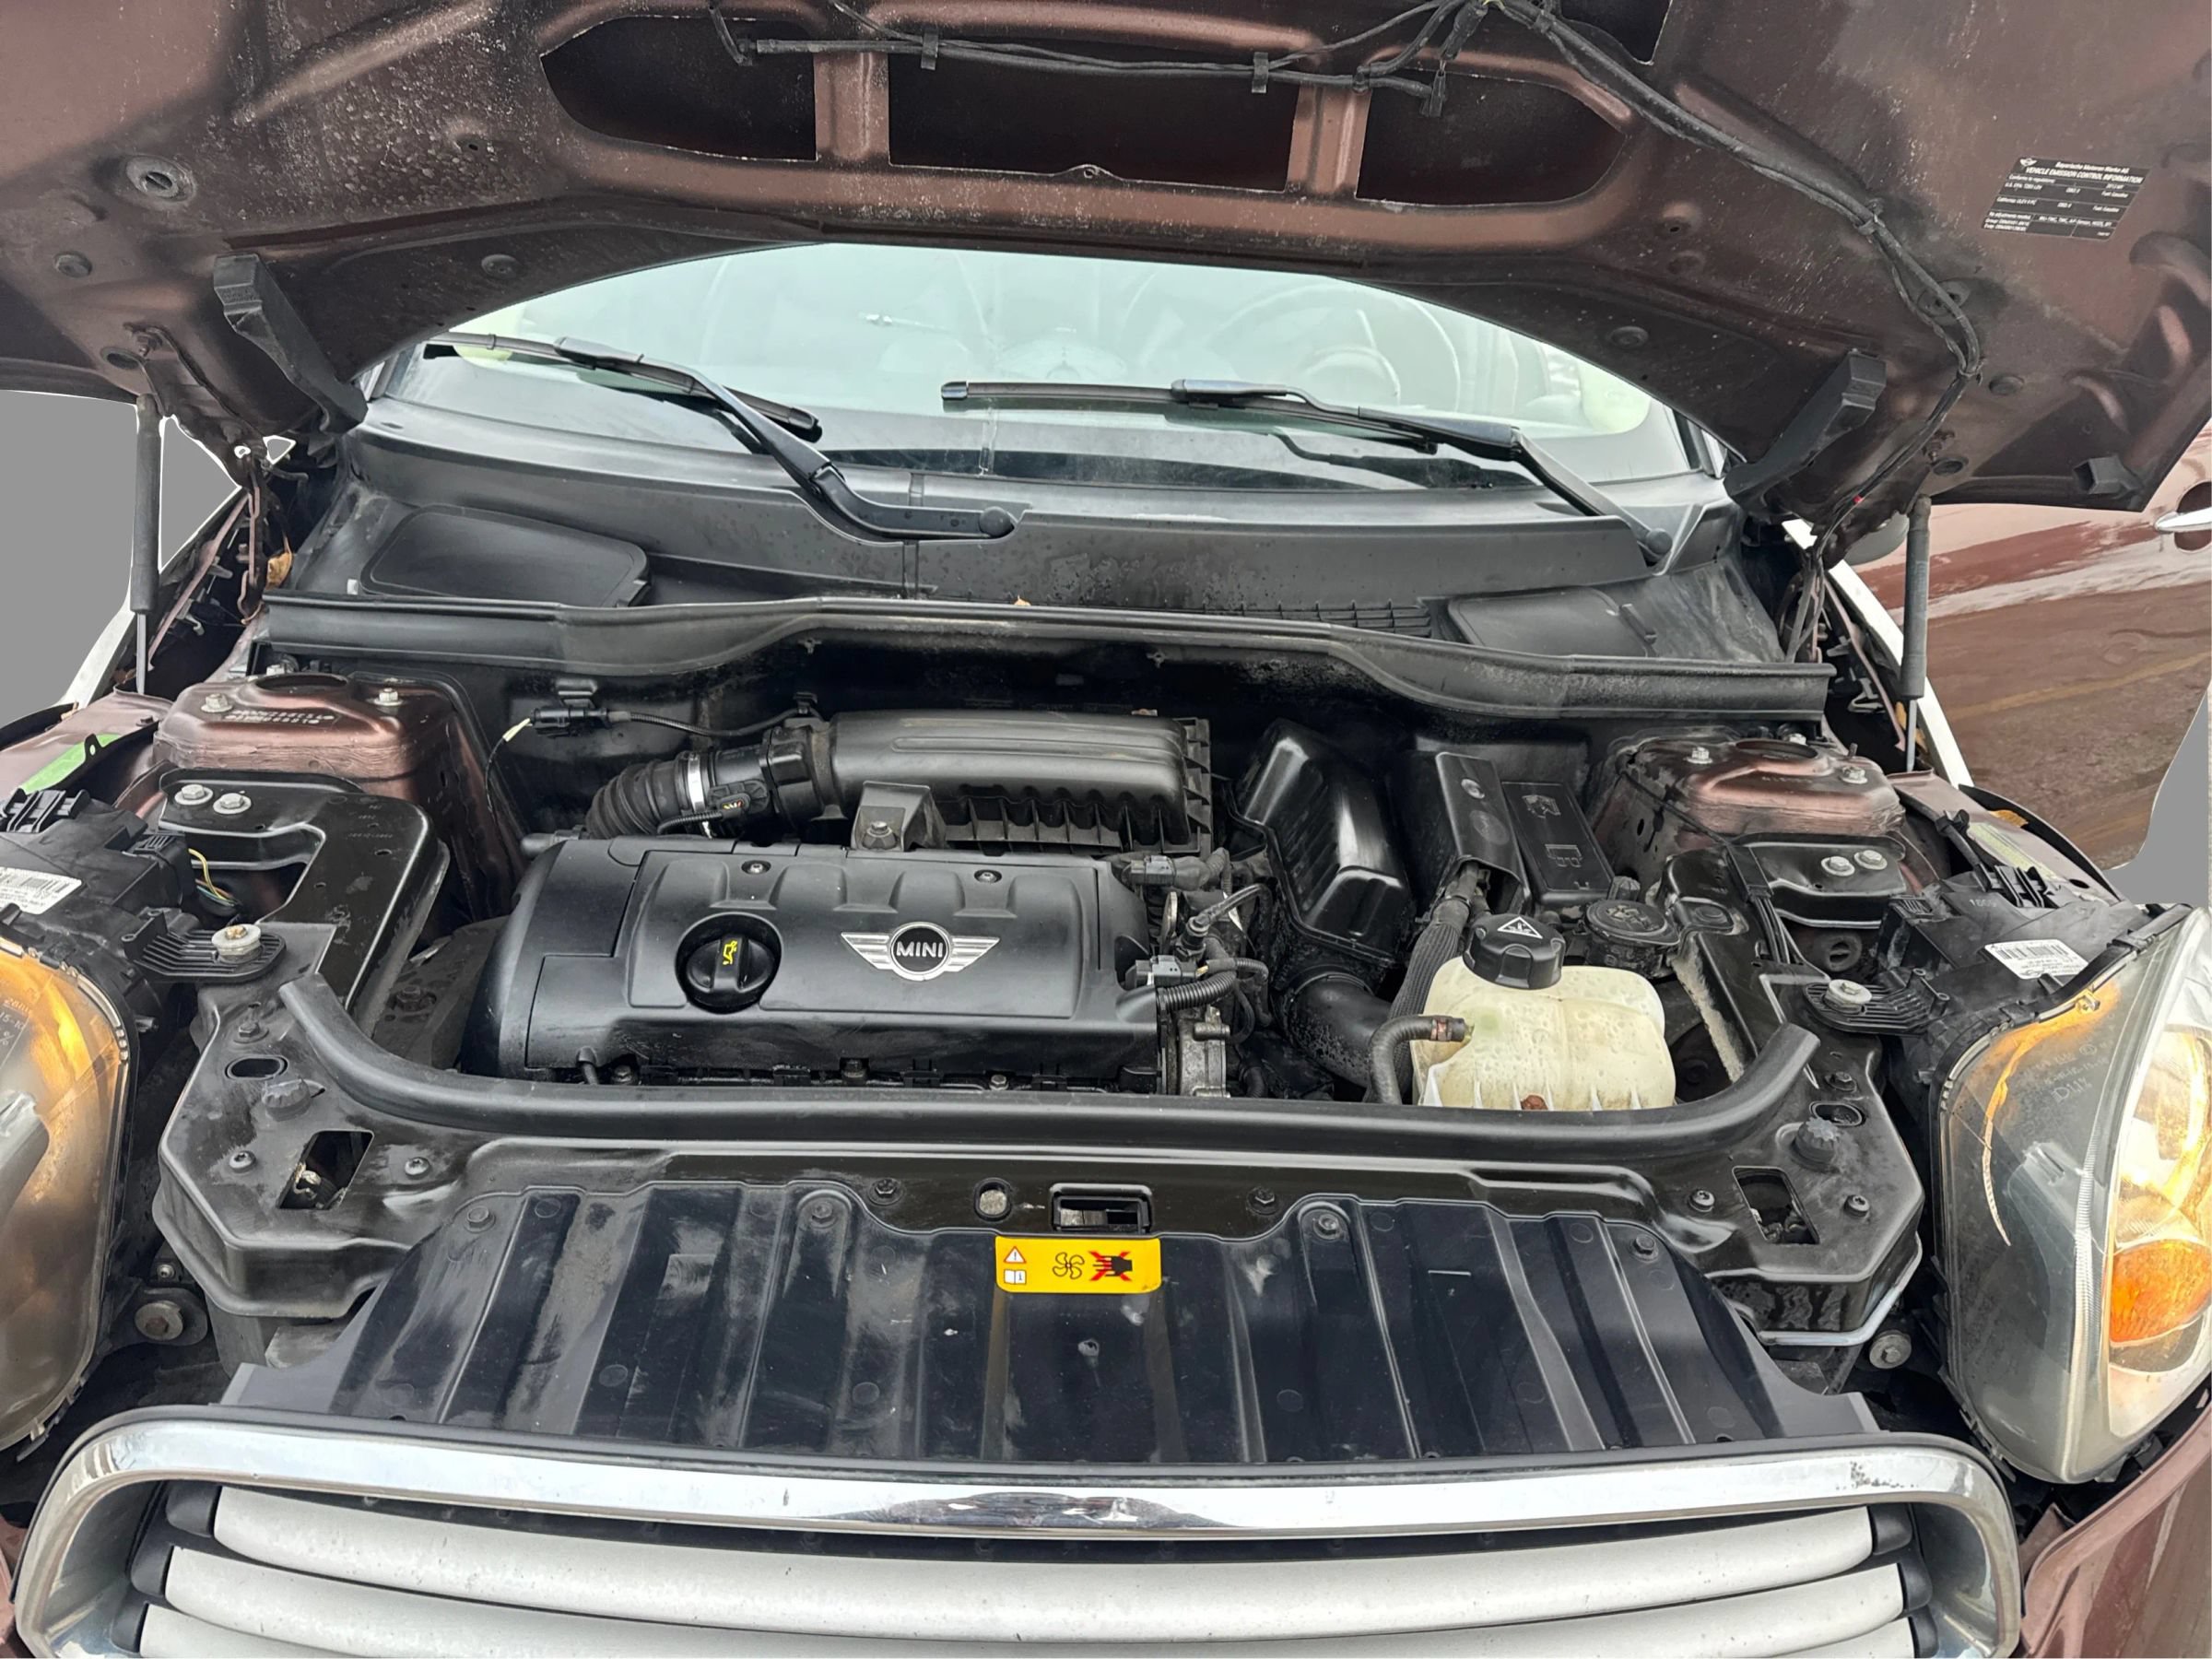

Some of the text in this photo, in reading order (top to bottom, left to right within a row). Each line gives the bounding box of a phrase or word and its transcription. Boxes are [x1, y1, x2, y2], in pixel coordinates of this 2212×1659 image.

[2025, 167, 2145, 184] VEHICLE EMISSION CONTROL INFORMATION
[896, 940, 944, 959] MINI
